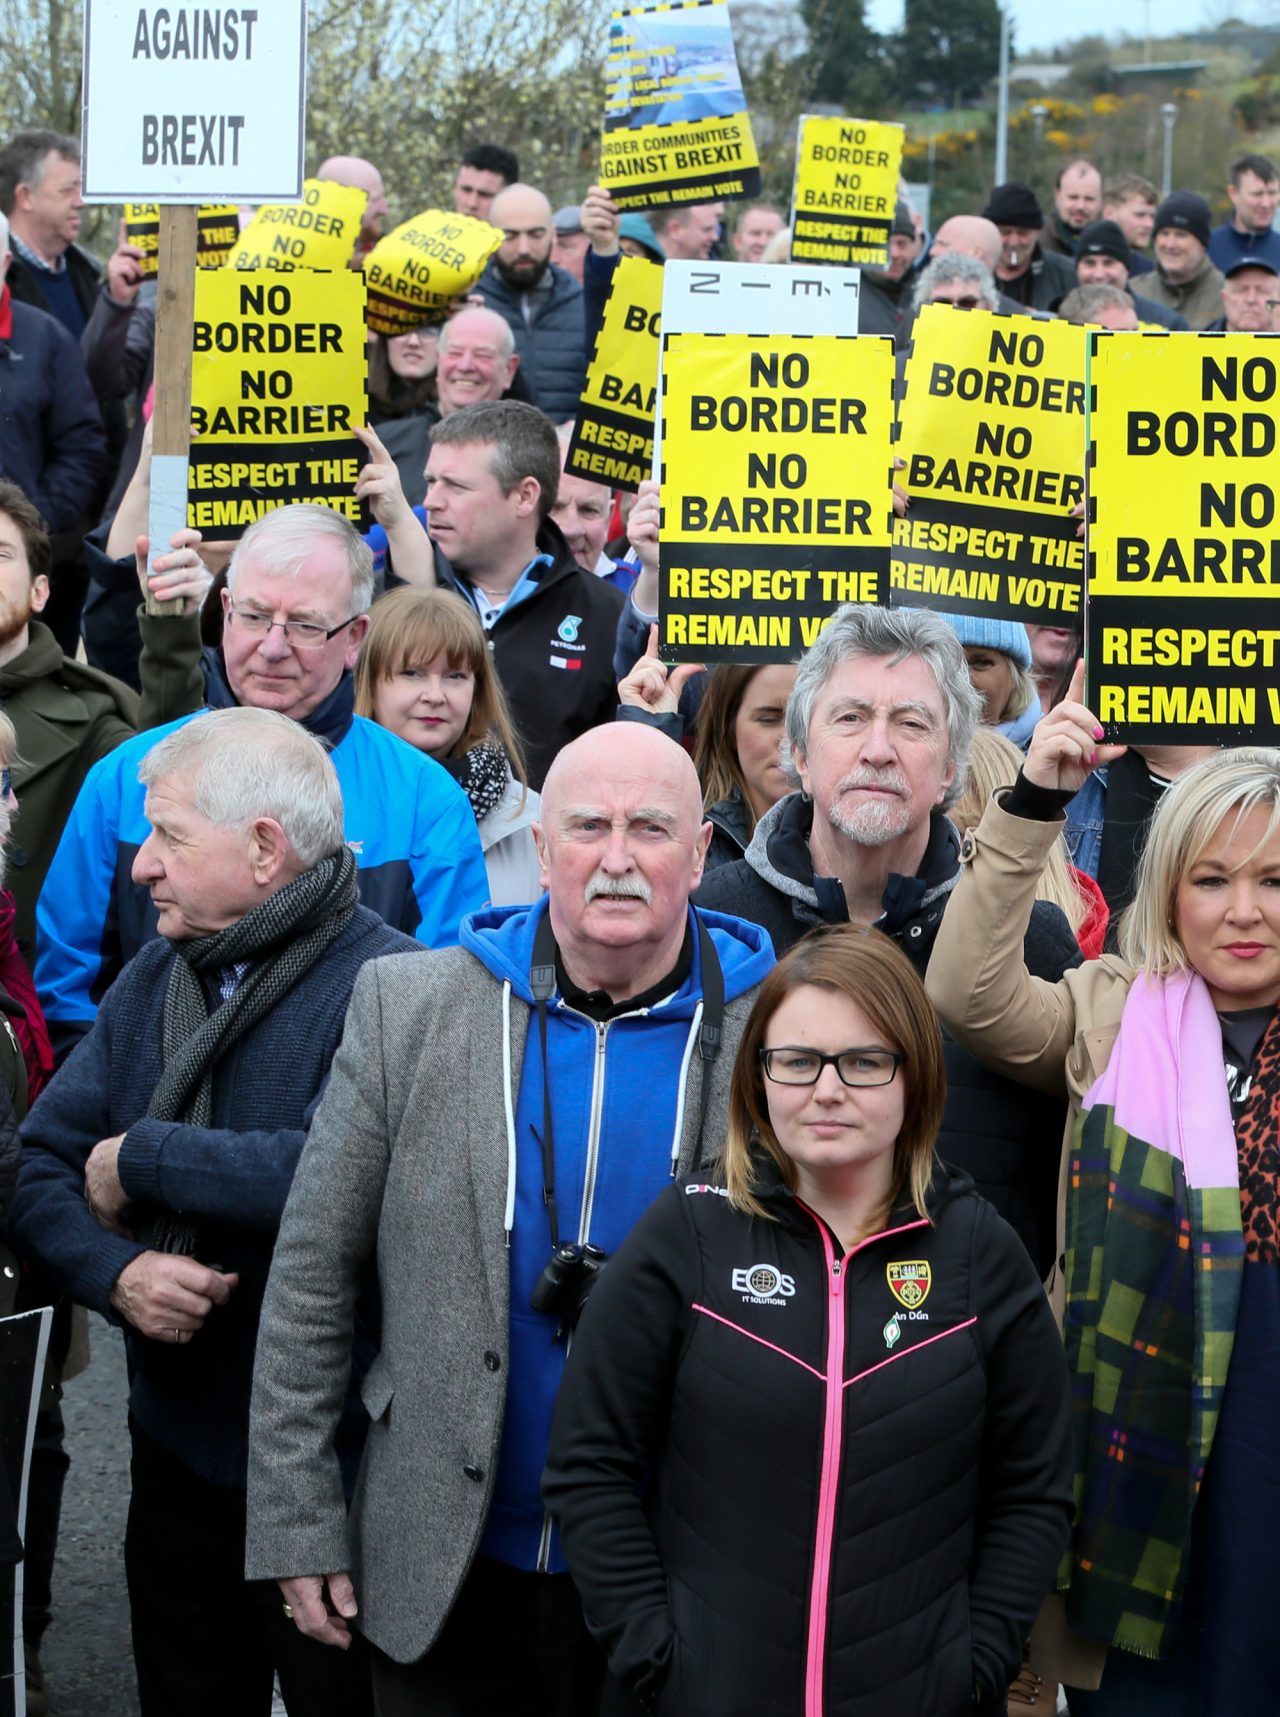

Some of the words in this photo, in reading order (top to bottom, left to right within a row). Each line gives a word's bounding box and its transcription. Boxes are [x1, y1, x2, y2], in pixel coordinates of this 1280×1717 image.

[132, 8, 258, 60] AGAINST
[142, 114, 245, 166] BREXIT
[644, 126, 741, 151] COMMUNITIES
[840, 127, 867, 145] NO
[601, 154, 668, 179] GAINST
[675, 142, 743, 169] BREXIT
[812, 144, 890, 168] BORDER
[715, 180, 744, 196] VOTE
[834, 172, 862, 191] NO
[804, 189, 888, 213] BARRIER
[202, 227, 236, 245] THE
[259, 208, 345, 239] BORDER
[434, 224, 463, 242] NO
[794, 219, 860, 242] RESPECT
[861, 226, 889, 244] THE
[272, 234, 306, 258] NO
[398, 228, 467, 273] BORDER
[792, 240, 850, 262] REMAIN
[851, 246, 889, 265] VOTE
[401, 257, 431, 285] NO
[239, 283, 291, 317] NO
[192, 321, 344, 354] BORDER
[988, 329, 1044, 368] NO
[240, 369, 293, 400] NO
[750, 351, 809, 389] NO
[1201, 355, 1277, 402] NO
[928, 362, 1086, 415] BORDER
[191, 403, 351, 435] BARRIER
[690, 395, 868, 435] BORDER
[974, 422, 1033, 460] NO
[306, 458, 359, 485] THE
[747, 452, 807, 489] NO
[908, 454, 1086, 507] BARRIER
[681, 495, 873, 536] BARRIER
[1199, 482, 1275, 529] NO
[891, 518, 1024, 561] RESPECT
[1029, 535, 1085, 570] THE
[668, 567, 811, 600] RESPECT
[818, 570, 878, 602] THE
[889, 559, 1000, 603] REMAIN
[1007, 575, 1082, 613] VOTE
[550, 640, 586, 651] PETRONAS
[666, 614, 791, 647] REMAIN
[1102, 627, 1280, 668] RESPECT
[1099, 684, 1258, 726] REMAIN
[732, 1263, 796, 1297] EOS
[750, 1297, 787, 1307] SOLUTIONS
